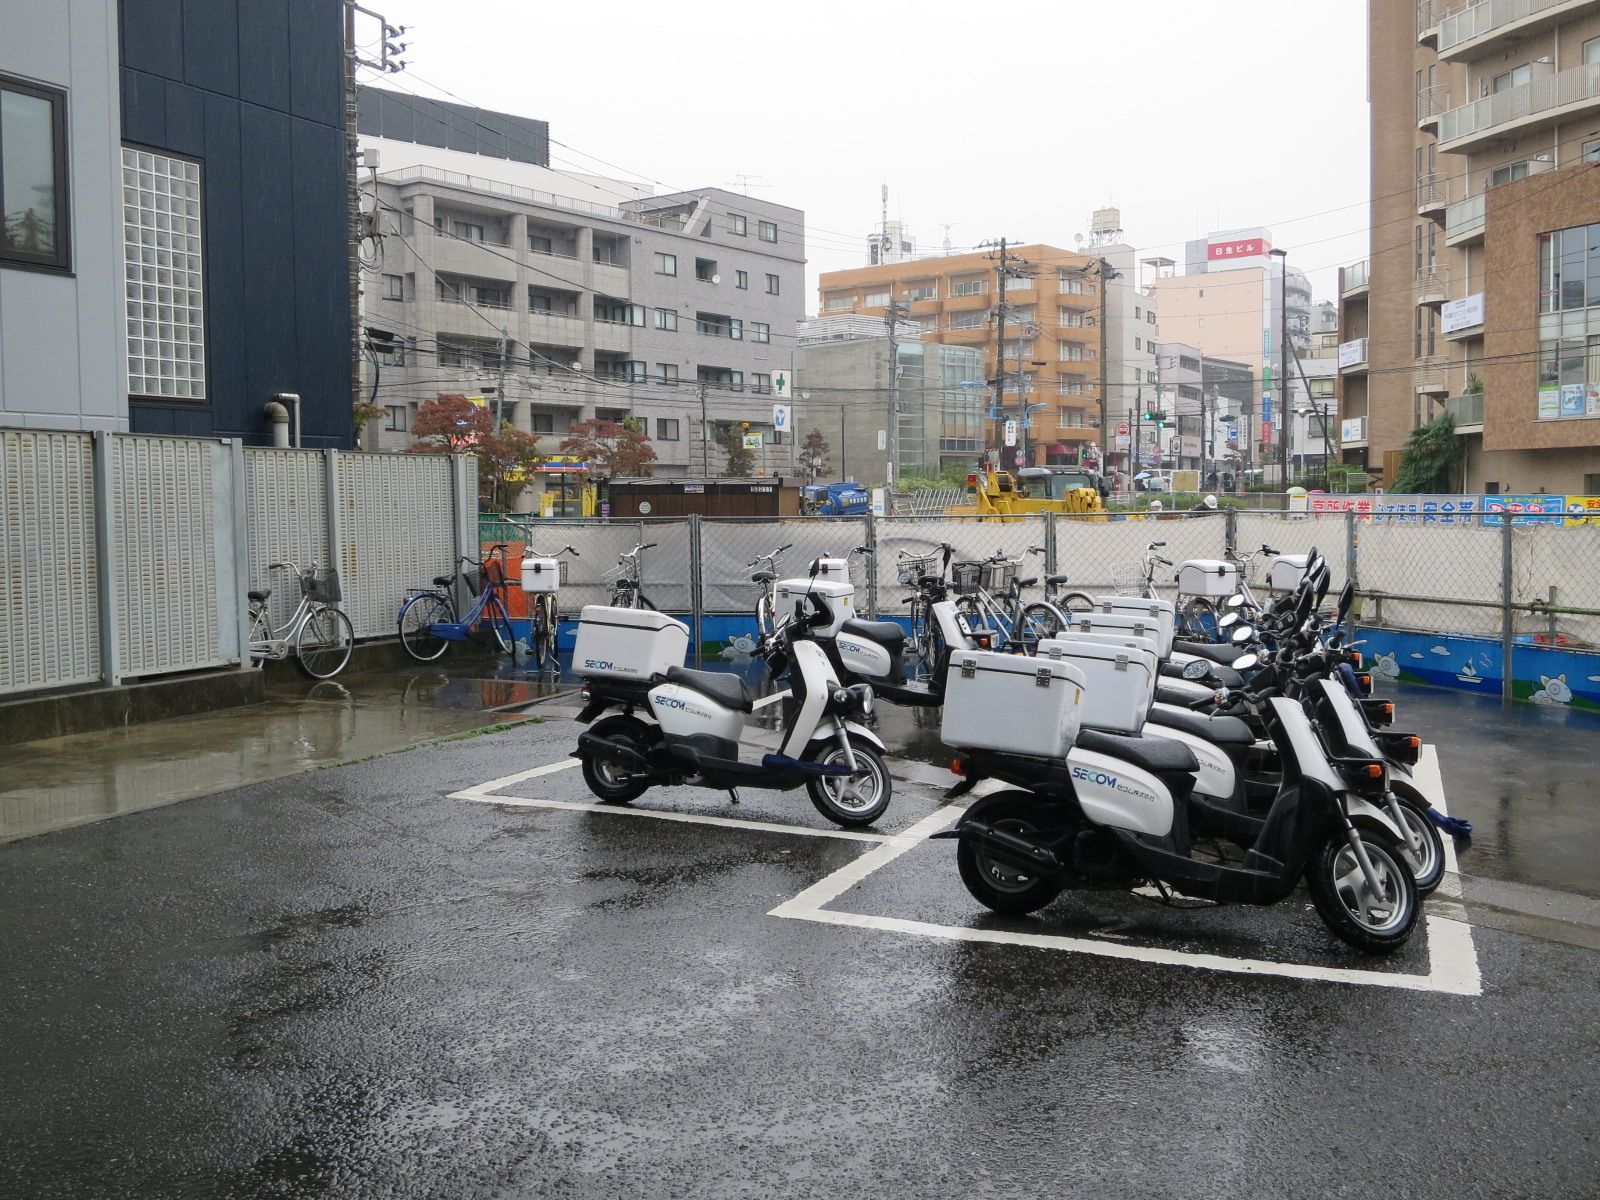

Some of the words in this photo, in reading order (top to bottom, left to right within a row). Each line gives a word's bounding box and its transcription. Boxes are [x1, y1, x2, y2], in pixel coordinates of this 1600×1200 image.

[1215, 243, 1254, 256] 日生ビル
[838, 642, 861, 654] SECOM
[584, 659, 613, 671] SECOM
[654, 695, 685, 711] SECOM
[1072, 767, 1117, 789] SECOM
[1116, 783, 1156, 802] セコム株式会社
